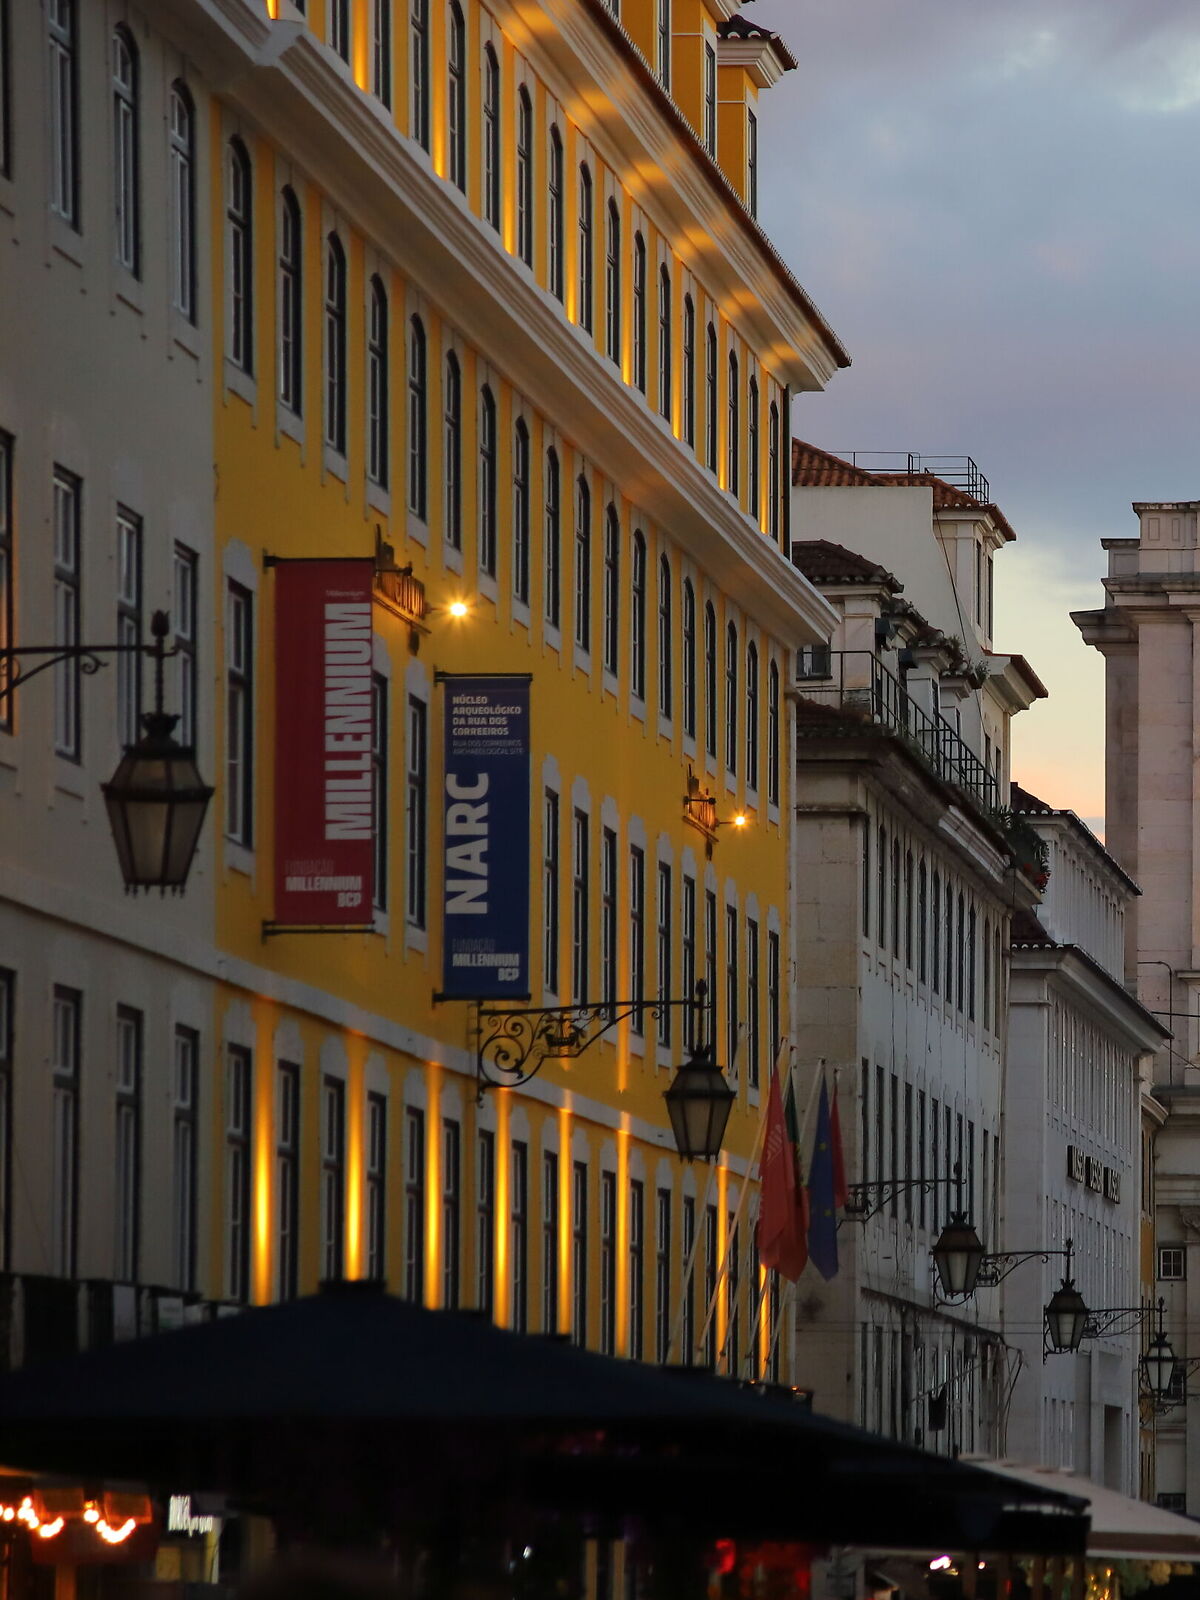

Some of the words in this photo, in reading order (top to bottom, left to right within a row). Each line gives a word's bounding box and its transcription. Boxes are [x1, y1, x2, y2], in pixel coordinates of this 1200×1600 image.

[452, 694, 488, 704] NÚCLEO
[452, 704, 522, 715] ARQUEOLÓGICO
[324, 602, 372, 840] MILLENNIUM
[452, 717, 466, 726] DA
[467, 717, 487, 726] RUA
[488, 717, 508, 726] DOS
[452, 727, 510, 736] CORREEIROS
[445, 772, 489, 915] NARC
[285, 875, 363, 892] MILLENNIUM
[337, 892, 362, 908] BCP
[452, 953, 520, 968] MILLENNIUM
[497, 967, 520, 981] BCP
